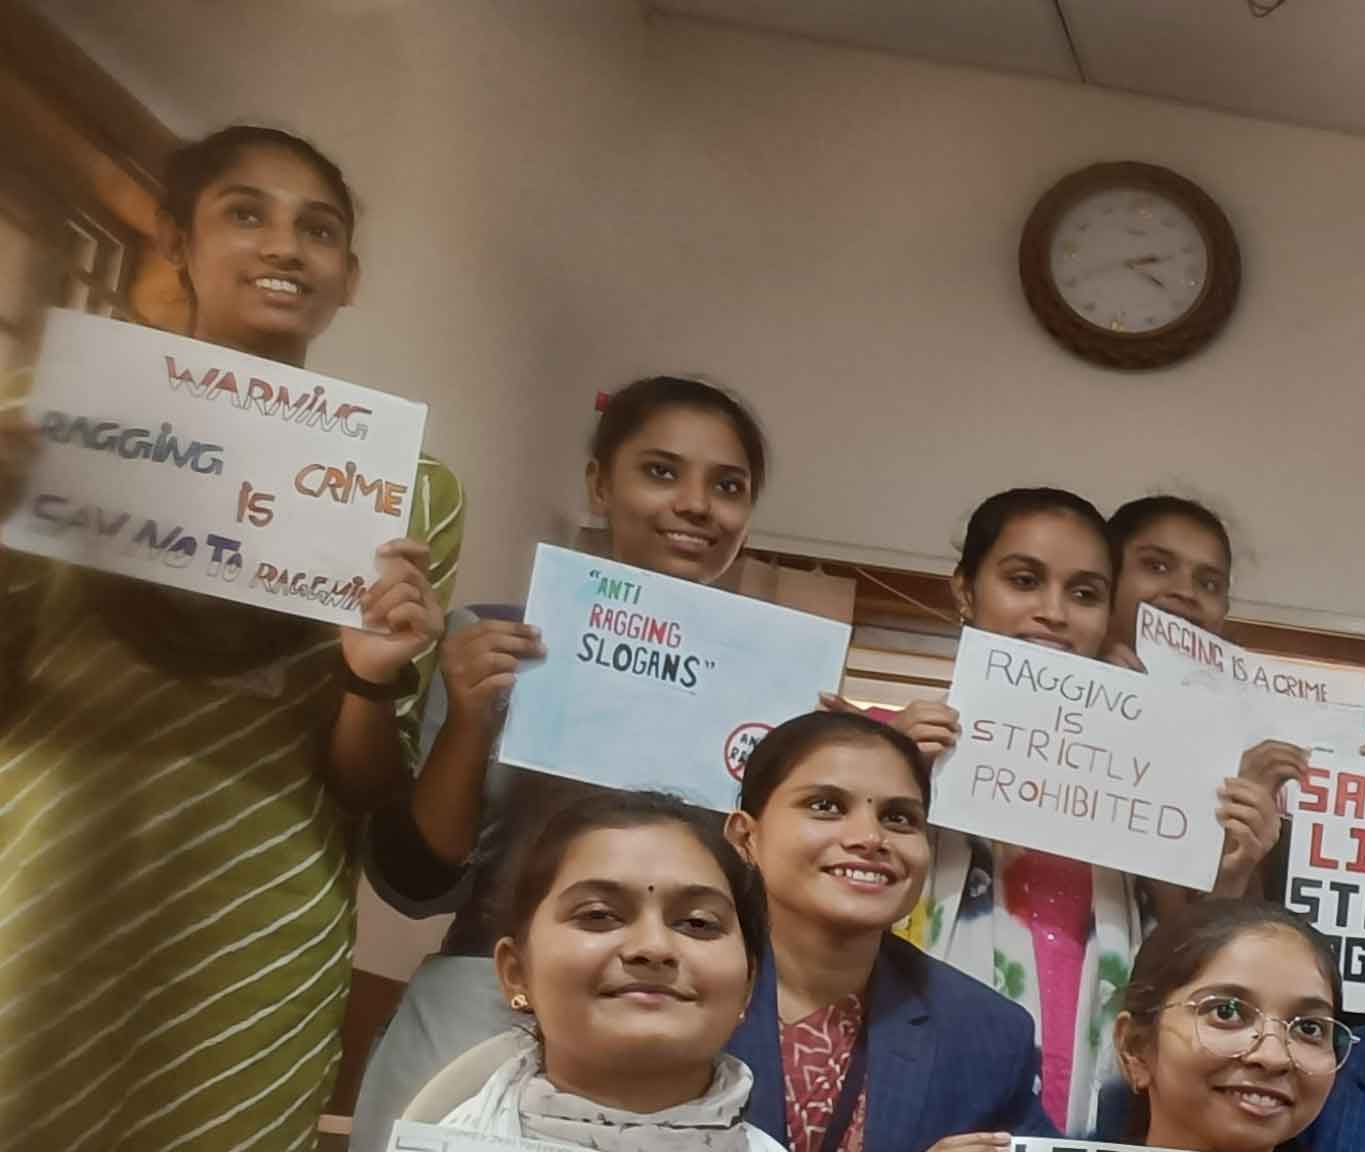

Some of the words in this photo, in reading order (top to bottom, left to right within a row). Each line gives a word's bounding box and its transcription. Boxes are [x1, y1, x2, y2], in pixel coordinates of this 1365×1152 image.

[985, 648, 1142, 721] RAGGING
[1140, 608, 1225, 673] RAGGING
[1231, 655, 1249, 682] IS
[1253, 667, 1272, 691] A
[1273, 673, 1329, 703] CRIME
[971, 719, 1151, 788] STRICTLY
[1054, 705, 1085, 735] IS
[970, 764, 1190, 840] PROHIBITED
